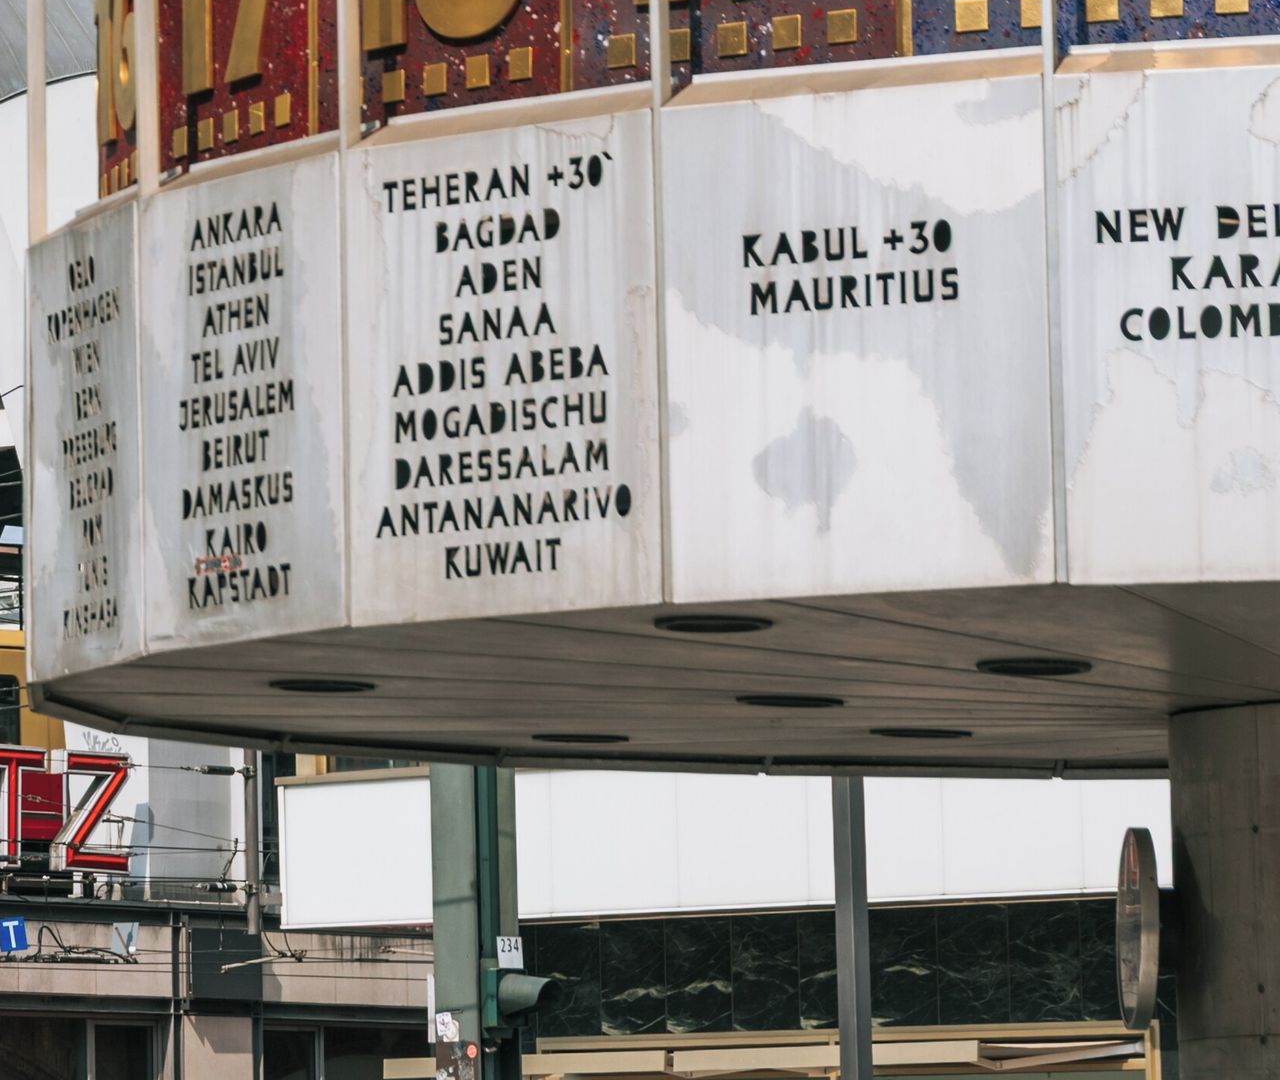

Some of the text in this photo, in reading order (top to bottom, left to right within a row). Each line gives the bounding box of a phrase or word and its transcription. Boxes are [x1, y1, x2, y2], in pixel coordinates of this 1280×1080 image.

[383, 163, 530, 214] TEHERAN
[190, 201, 283, 252] ANKARA
[435, 208, 560, 254] BAGDAD
[741, 218, 952, 268] KABUL +30
[1094, 204, 1280, 244] NEW DE
[187, 246, 284, 297] ISTANBUL
[454, 256, 542, 298] ADEN
[750, 266, 959, 316] MAURITIUS
[47, 286, 120, 345] KOPENHAGEN
[202, 293, 270, 338] ATHEN
[439, 302, 556, 346] SANAA
[72, 340, 100, 377] WIEN
[191, 337, 280, 384] TEL AVIV
[392, 344, 609, 398] ADDIS ABEBA
[75, 383, 102, 421] BERN
[179, 379, 295, 432] JERUSALEM
[394, 390, 607, 444] MOGADISCHU
[202, 429, 270, 472] BEIRUT
[394, 438, 609, 490] DARESSALAM
[70, 466, 113, 511] BELGRAD
[182, 471, 293, 520] DAMASKUS
[376, 483, 631, 539] ANTANANARIVO
[82, 513, 103, 551] ROM
[206, 521, 267, 557] KAIRO
[444, 537, 562, 580] KUWAIT
[188, 563, 290, 609] KAPSTADT
[501, 938, 519, 953] 234
